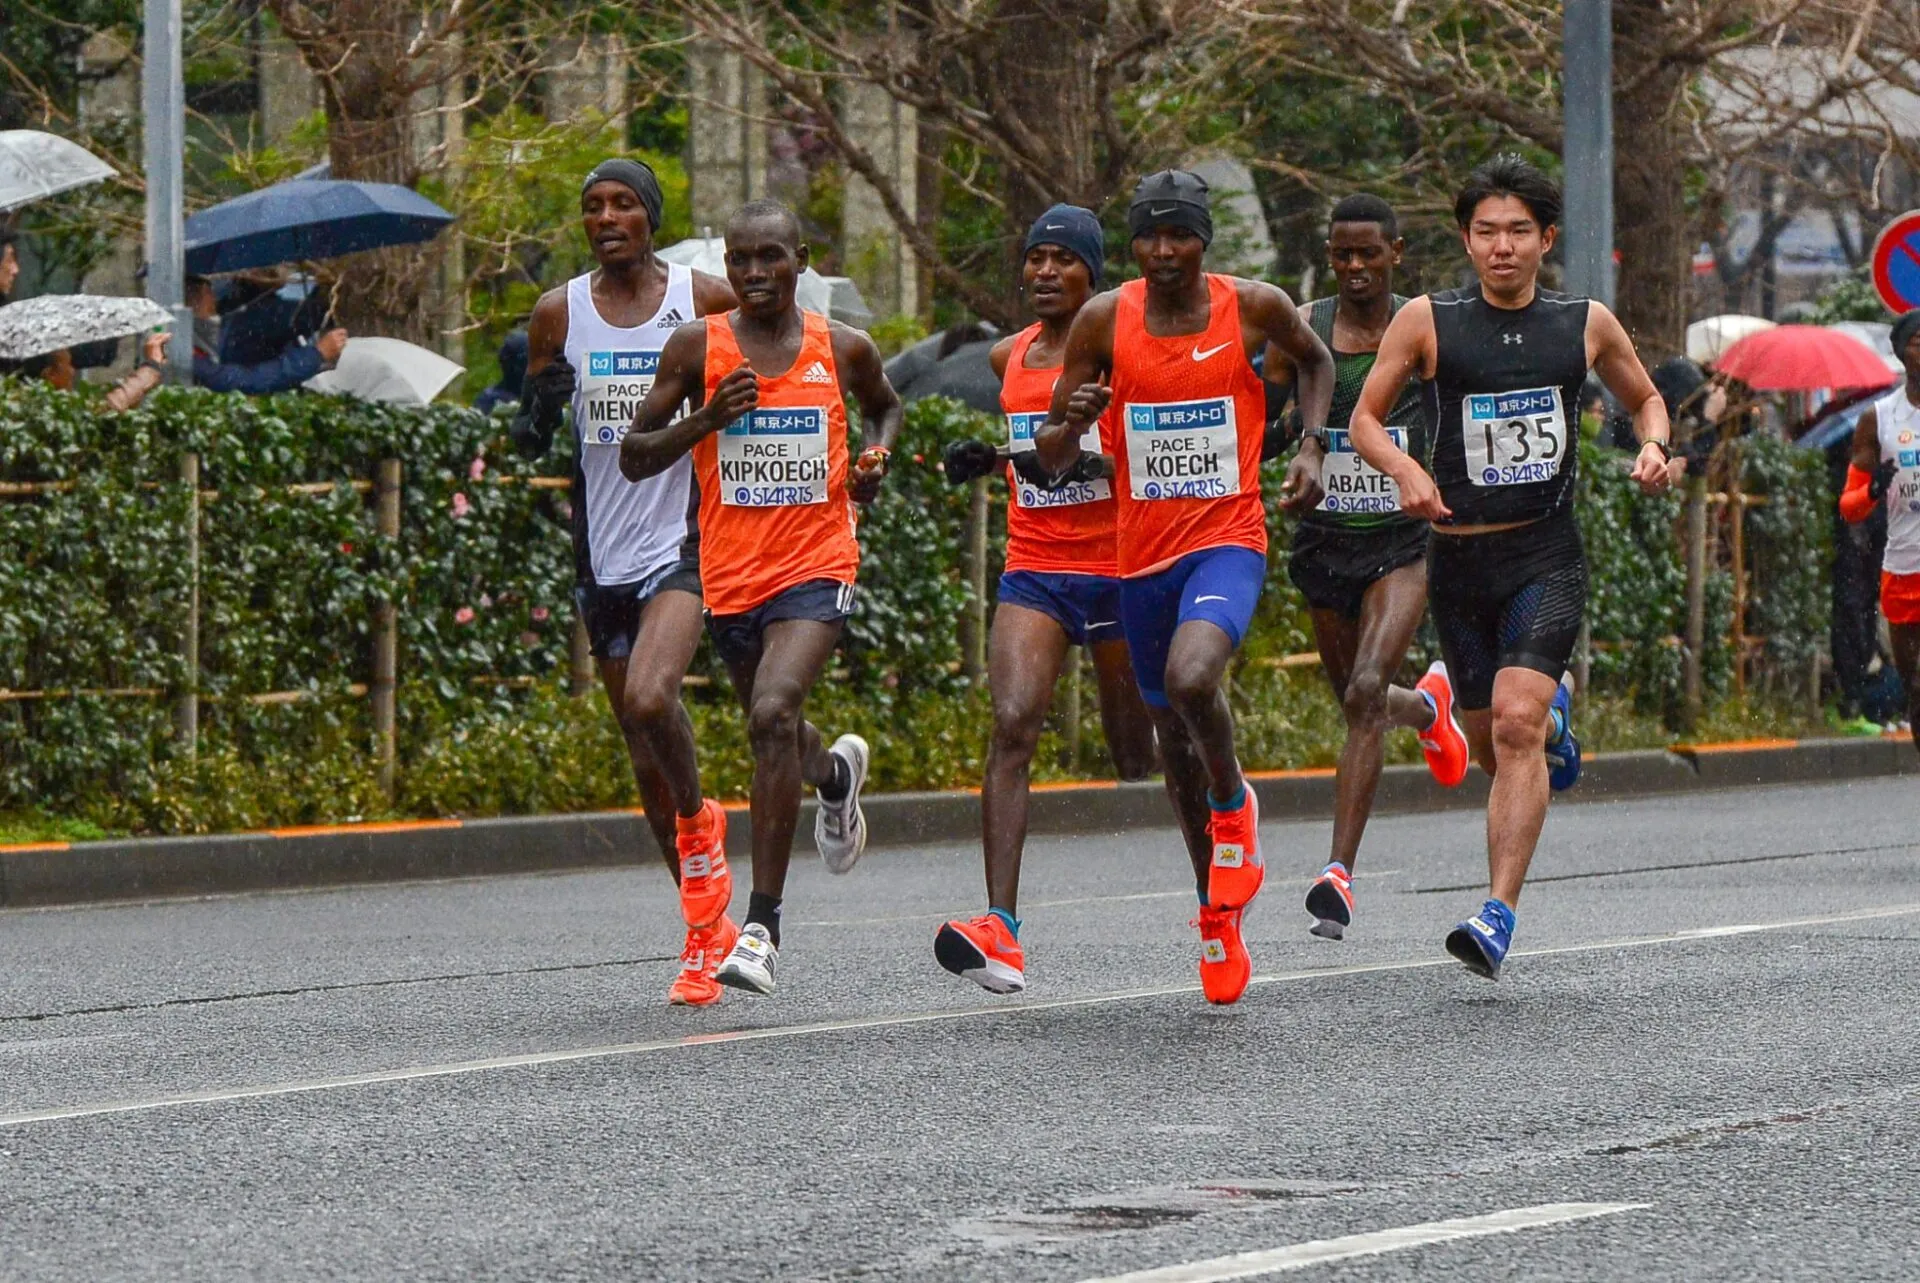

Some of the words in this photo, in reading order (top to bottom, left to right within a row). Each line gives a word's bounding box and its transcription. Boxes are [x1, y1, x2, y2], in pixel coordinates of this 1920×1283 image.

[802, 375, 832, 383] adidas
[607, 383, 650, 397] PACE
[1498, 396, 1551, 413] 東京メトロ
[753, 416, 815, 429] 東京メトロ
[1158, 408, 1221, 425] 東京メトロ
[1151, 438, 1195, 452] PACE
[1202, 437, 1210, 449] 3
[1484, 416, 1558, 465] 135
[743, 444, 788, 457] PACE
[720, 460, 826, 482] KIPKOECH
[1146, 452, 1219, 478] KOECH
[1353, 456, 1362, 472] 9
[1328, 474, 1391, 493] ABATE
[1899, 483, 1920, 498] KIP
[752, 486, 813, 505] STARTS
